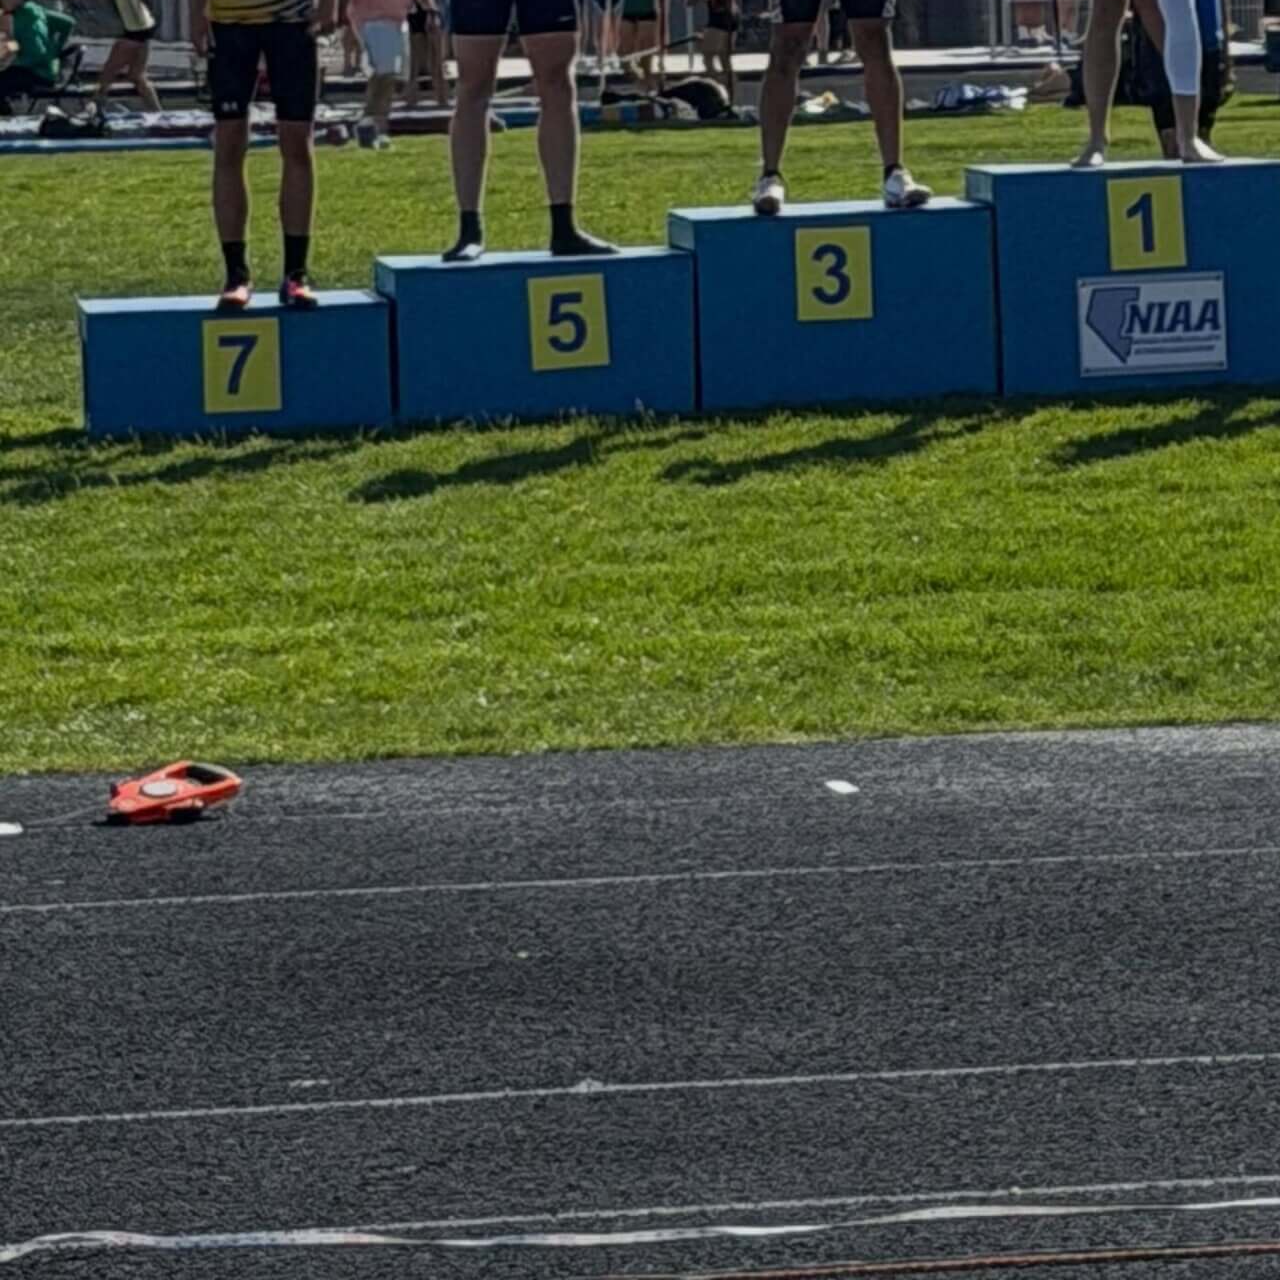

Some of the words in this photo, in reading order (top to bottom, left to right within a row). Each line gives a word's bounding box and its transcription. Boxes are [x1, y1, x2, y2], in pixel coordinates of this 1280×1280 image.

[1126, 192, 1156, 253] 1
[811, 242, 852, 305] 3
[547, 291, 588, 353] 5
[1124, 299, 1221, 334] NIAA
[217, 334, 259, 396] 7
